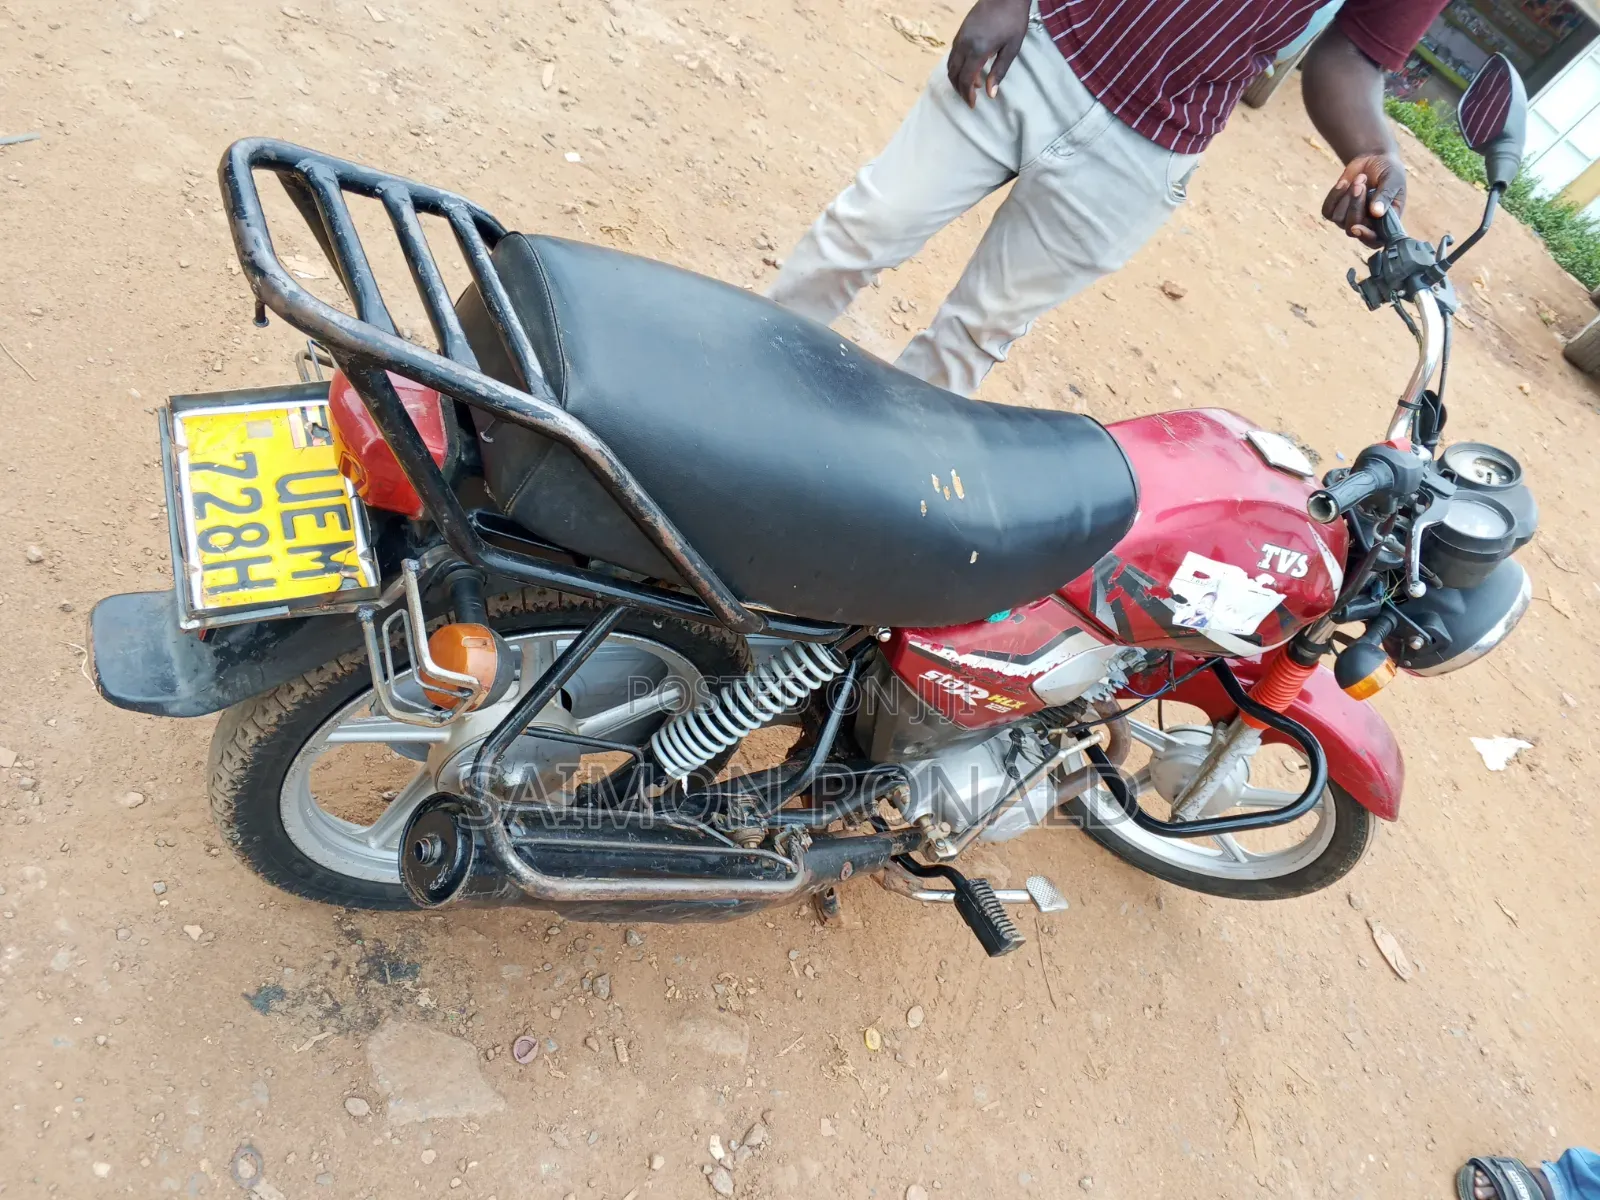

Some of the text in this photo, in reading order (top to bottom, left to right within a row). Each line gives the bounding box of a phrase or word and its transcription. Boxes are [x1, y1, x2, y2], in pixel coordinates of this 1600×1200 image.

[189, 451, 277, 596] 728H
[275, 468, 359, 580] UEM
[1257, 543, 1309, 578] TVS
[987, 694, 1027, 709] HLX
